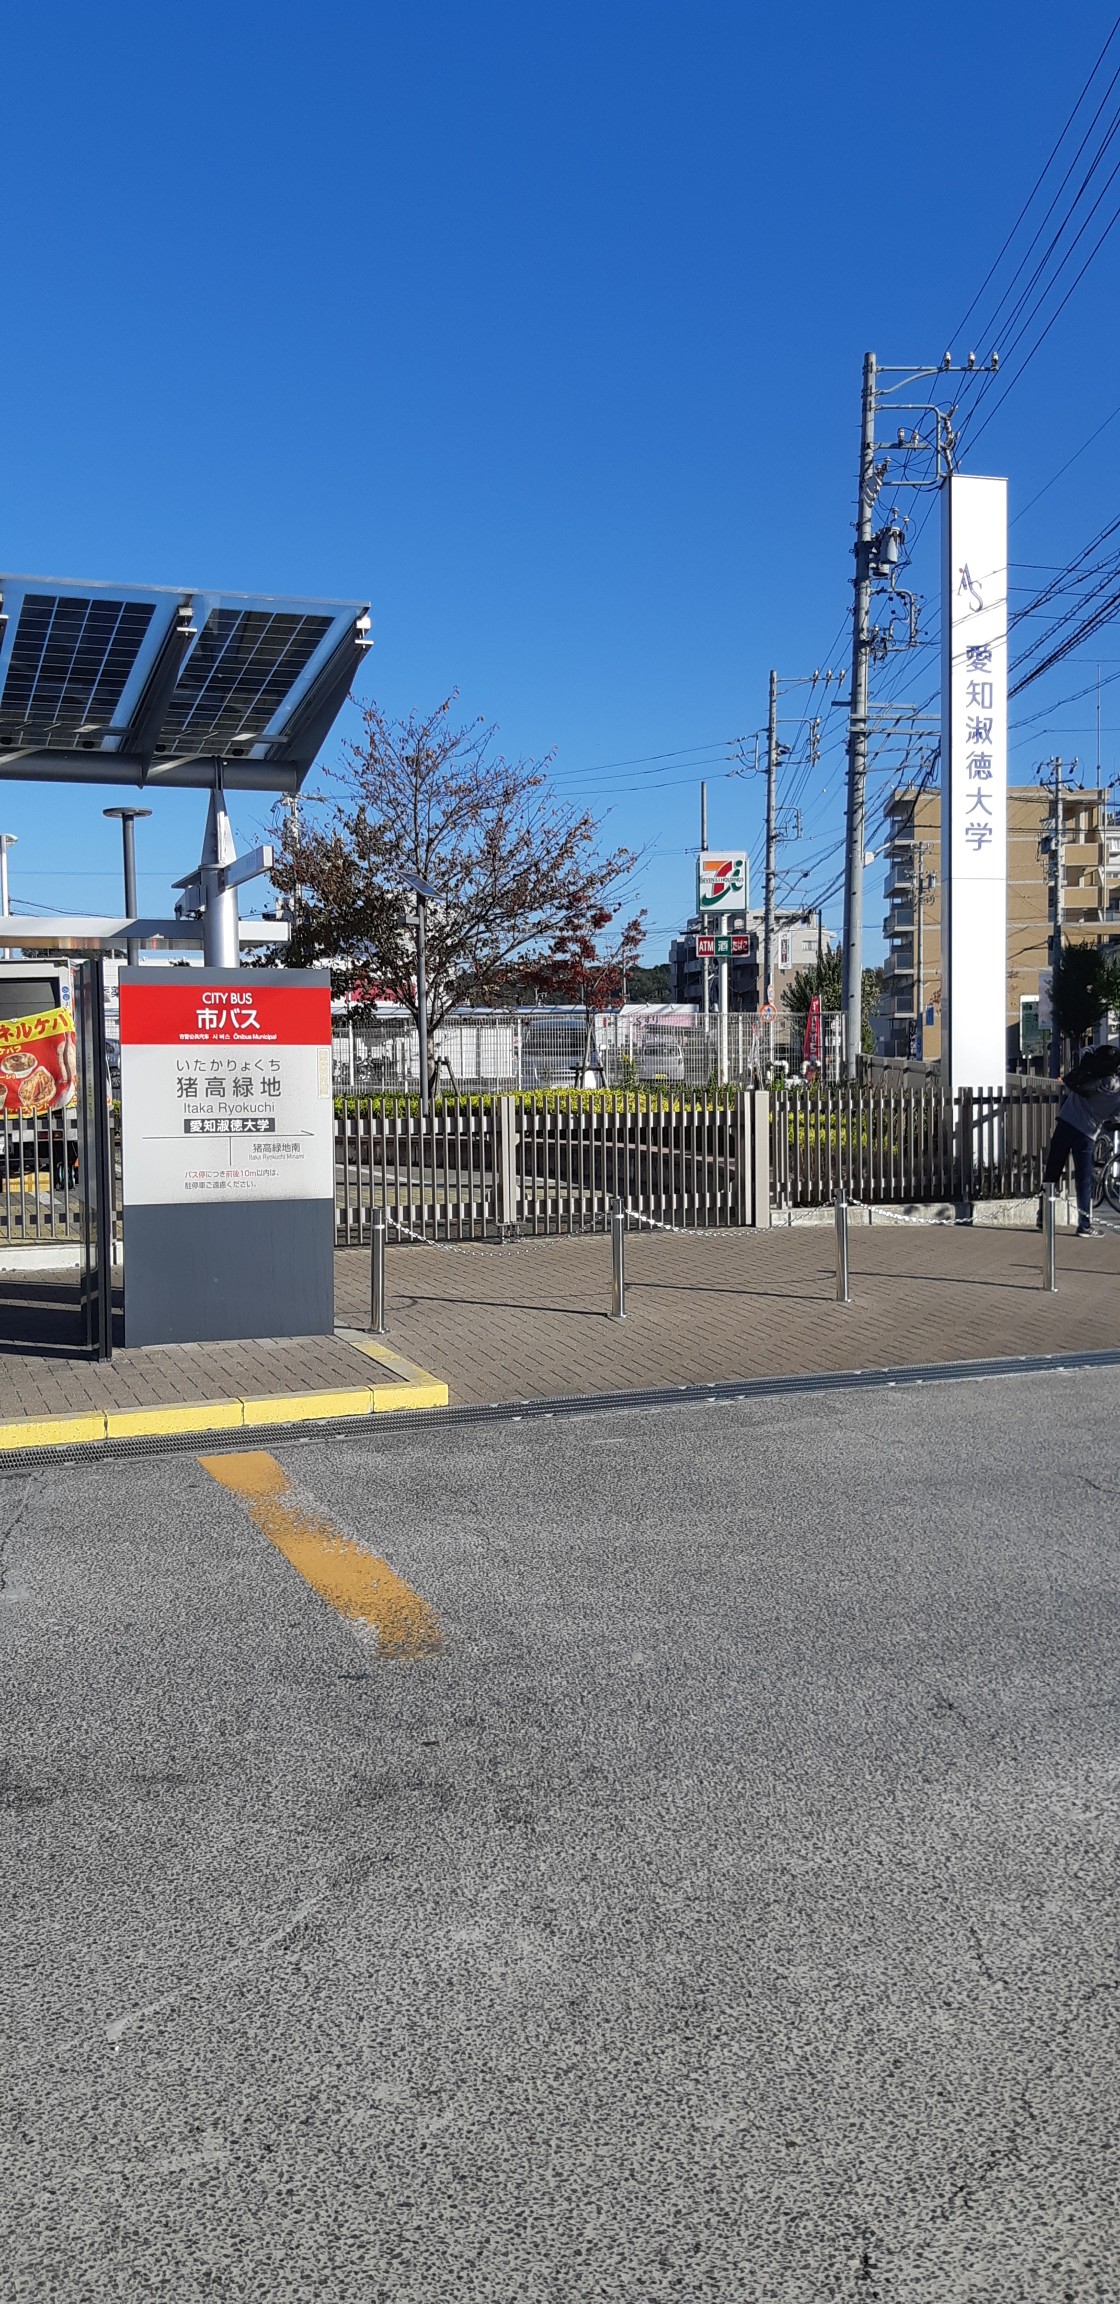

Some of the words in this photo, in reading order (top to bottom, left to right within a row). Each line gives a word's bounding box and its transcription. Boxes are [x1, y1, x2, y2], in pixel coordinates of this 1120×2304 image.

[965, 643, 993, 851] 愛知淑徳大学
[699, 941, 714, 952] ATM
[717, 940, 729, 952] 酒
[202, 992, 228, 1004] CITY
[230, 992, 253, 1005] BUS
[0, 1009, 72, 1042] ネルケバ
[196, 1007, 261, 1030] 市バス
[252, 1033, 277, 1041] Municipal
[176, 1058, 281, 1072] いたかりょくち
[176, 1076, 282, 1099] 猪高緑地
[183, 1102, 214, 1114] Itaka
[218, 1101, 275, 1116] Ryokuchi
[189, 1119, 270, 1133] 愛知淑徳大学
[252, 1142, 301, 1154] 猪高緑地南
[262, 1153, 286, 1162] Ryokuchi
